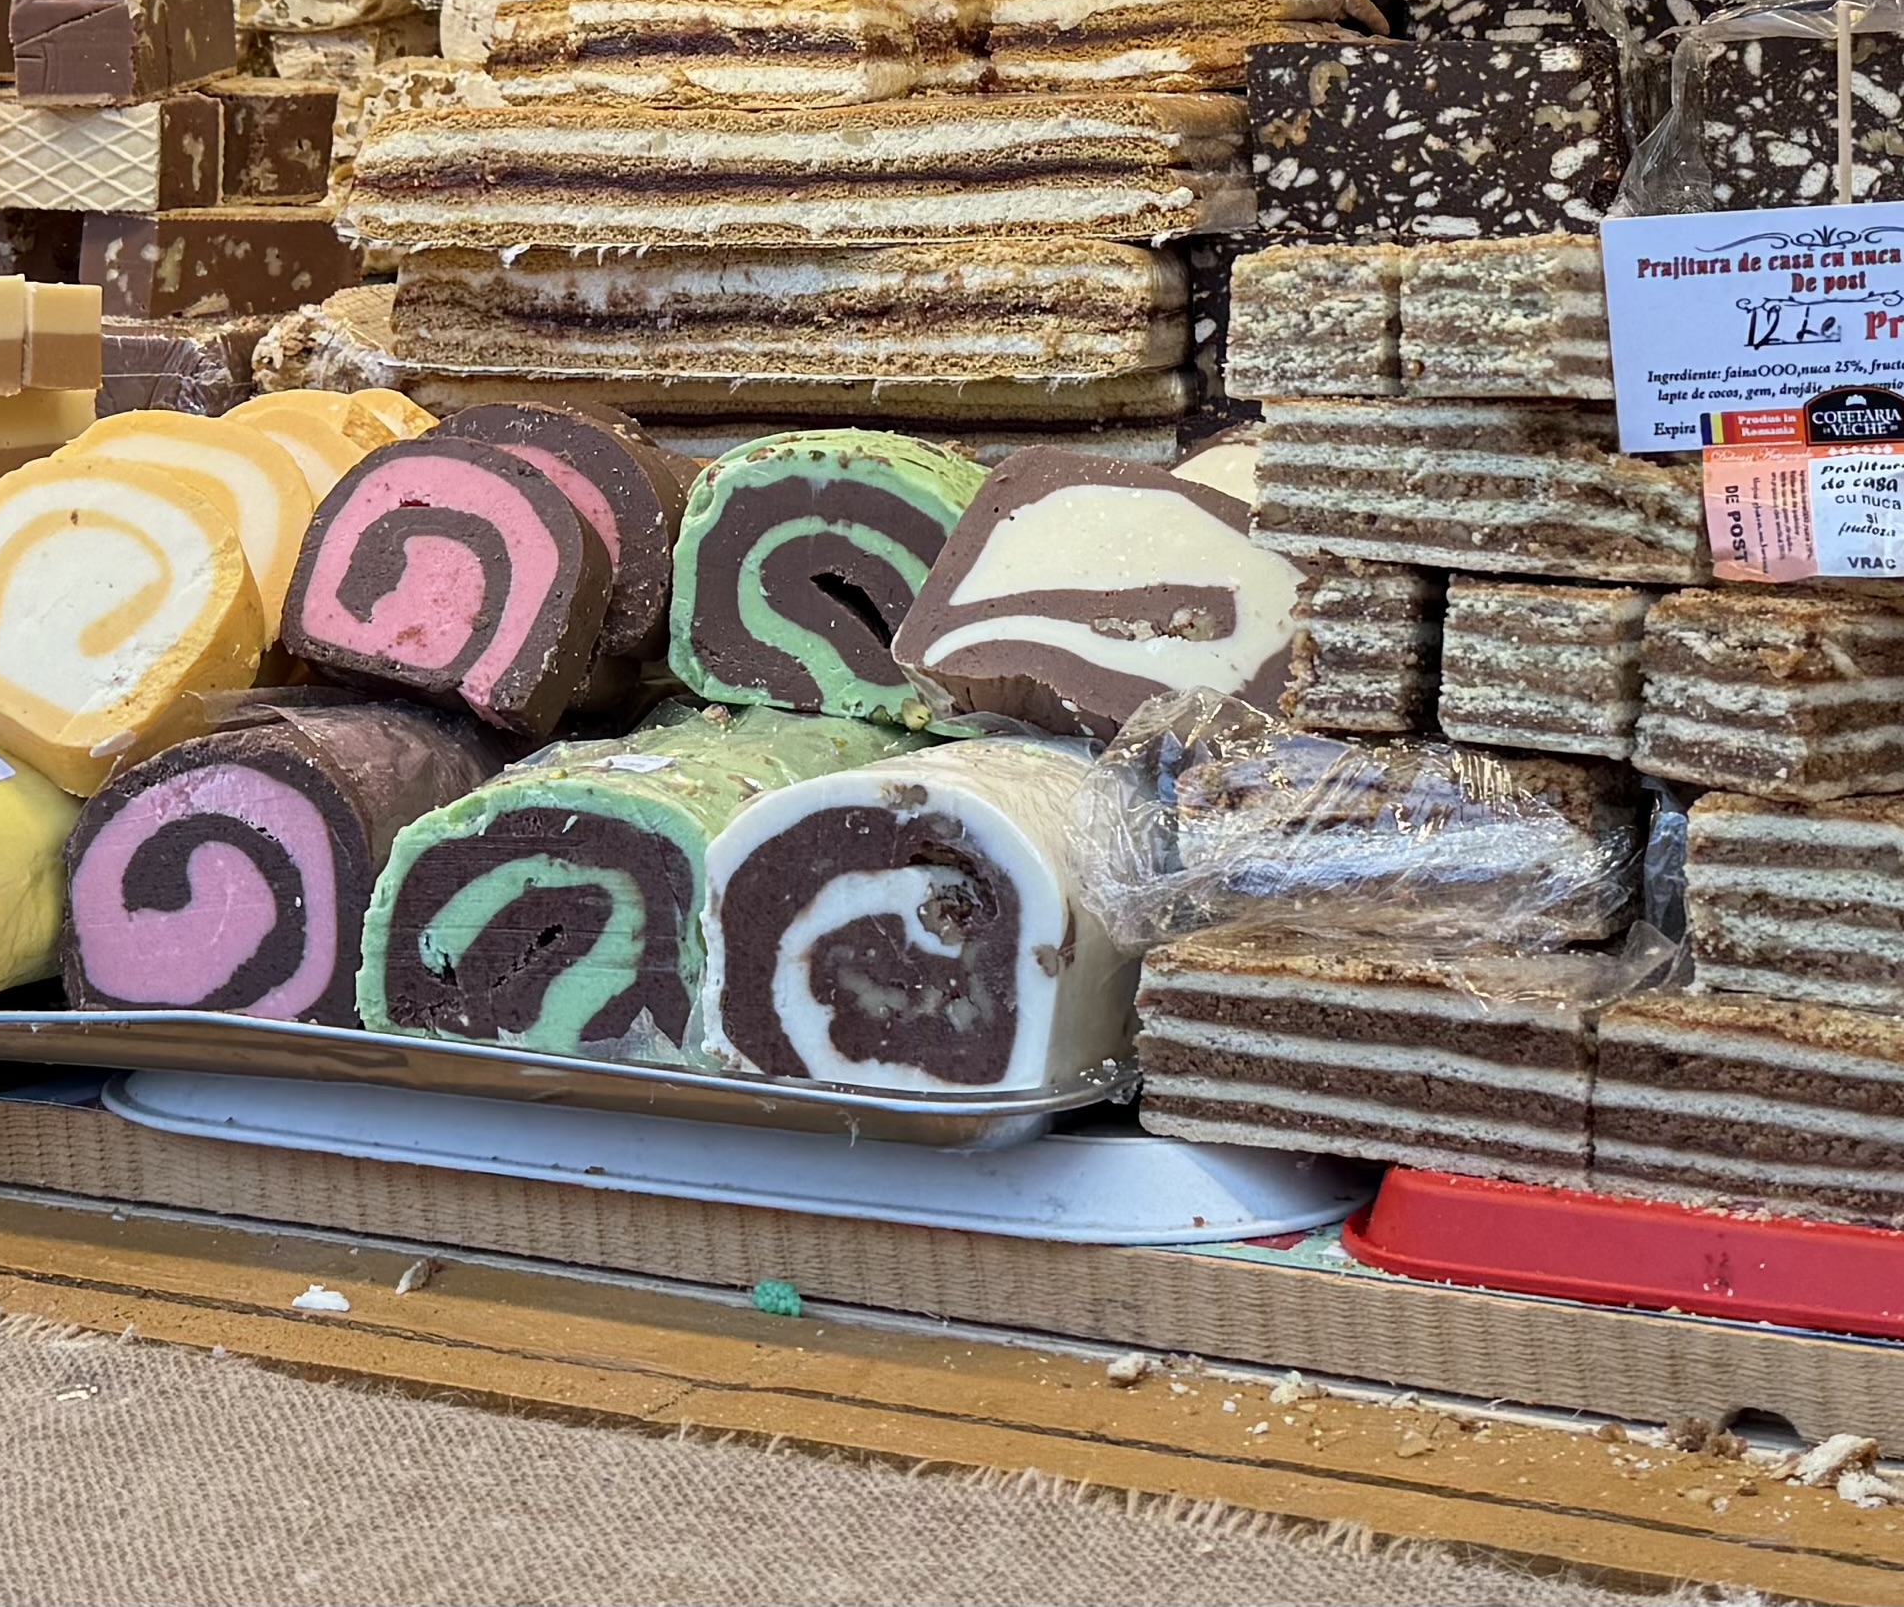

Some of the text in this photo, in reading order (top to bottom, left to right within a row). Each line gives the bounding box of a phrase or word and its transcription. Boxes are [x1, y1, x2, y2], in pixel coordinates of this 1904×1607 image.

[1637, 256, 1731, 280] Prajitura
[1738, 252, 1761, 272] de
[1768, 253, 1814, 271] casa
[1820, 252, 1845, 268] cu
[1851, 247, 1902, 266] nuca
[1791, 271, 1867, 294] De post
[1747, 305, 1784, 350] 12
[1647, 370, 1721, 385] Ingrediente:
[1834, 359, 1868, 374] 25%,
[1658, 389, 1689, 405] lapte
[1692, 388, 1705, 400] de
[1708, 388, 1743, 400] cocos,
[1746, 387, 1776, 401] gem,
[1812, 408, 1902, 425] COFETARIA
[1653, 422, 1696, 439] Expira
[1830, 423, 1889, 436] VECHE
[1821, 476, 1899, 493] de casa
[1834, 493, 1902, 511] cu nuca
[1724, 485, 1749, 563] DE POST
[1865, 513, 1879, 525] si
[1847, 557, 1897, 570] VRAC
